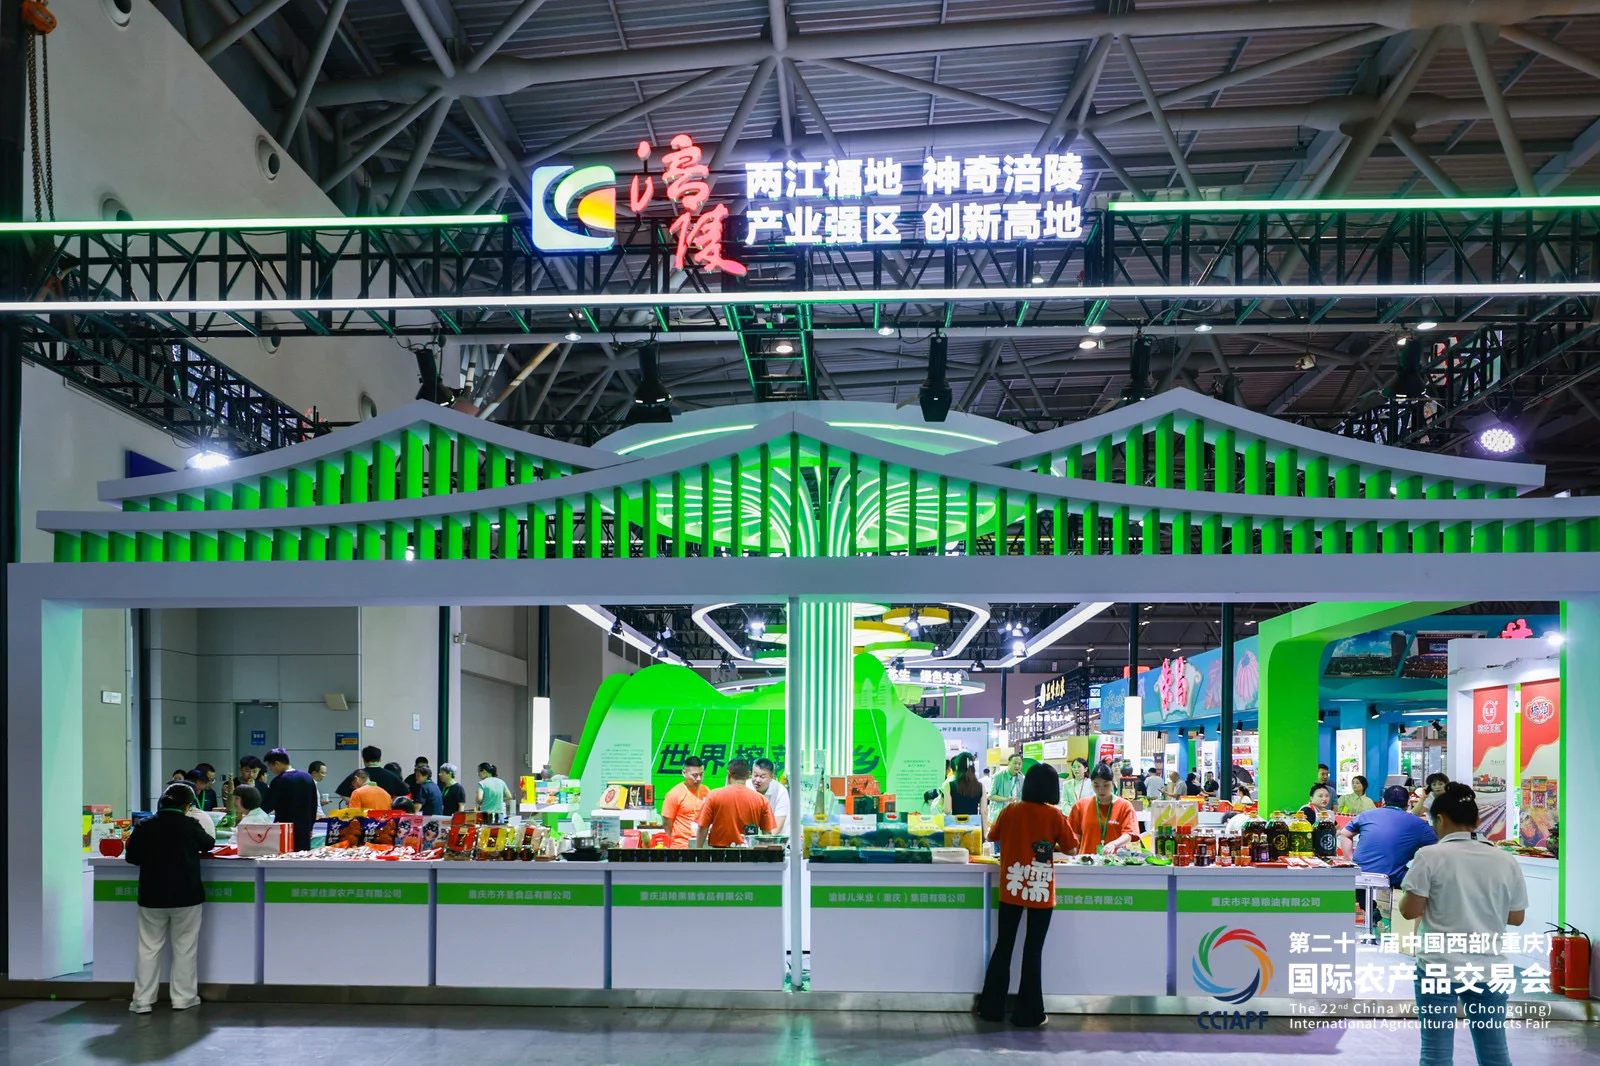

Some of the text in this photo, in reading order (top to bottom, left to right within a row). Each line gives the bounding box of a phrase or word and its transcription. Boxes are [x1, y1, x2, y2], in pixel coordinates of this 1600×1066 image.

[745, 153, 1083, 199] 两江福地 神奇涪陵
[629, 134, 747, 275] 涪陵
[745, 201, 1083, 245] 产业强区 创新高地
[1006, 861, 1053, 903] 糯
